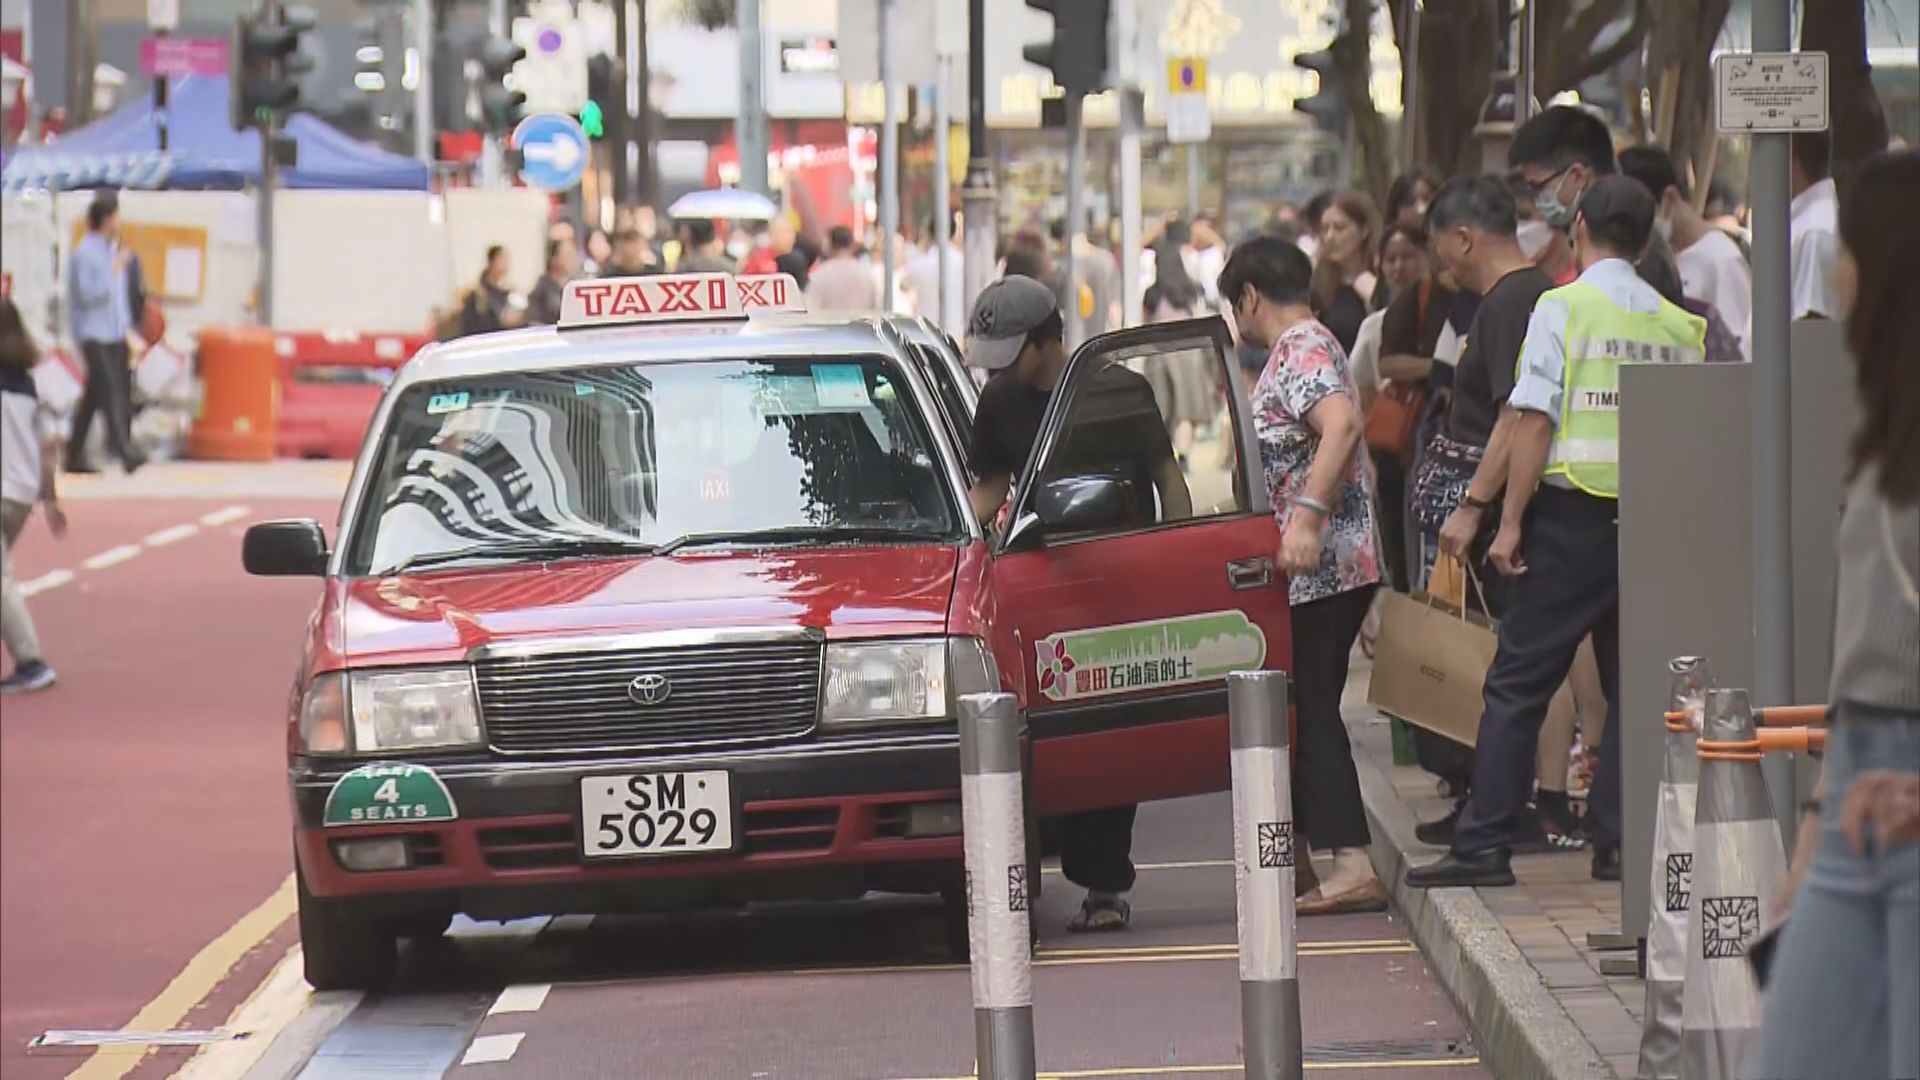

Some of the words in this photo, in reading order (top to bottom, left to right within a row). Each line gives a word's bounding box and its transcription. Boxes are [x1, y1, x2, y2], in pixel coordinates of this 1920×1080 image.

[575, 279, 727, 317] TAXI
[1075, 655, 1193, 693] 豐田石油氣的士
[374, 778, 400, 803] 4
[625, 773, 686, 811] SM
[350, 804, 428, 820] SEATS
[598, 808, 717, 849] 5029
